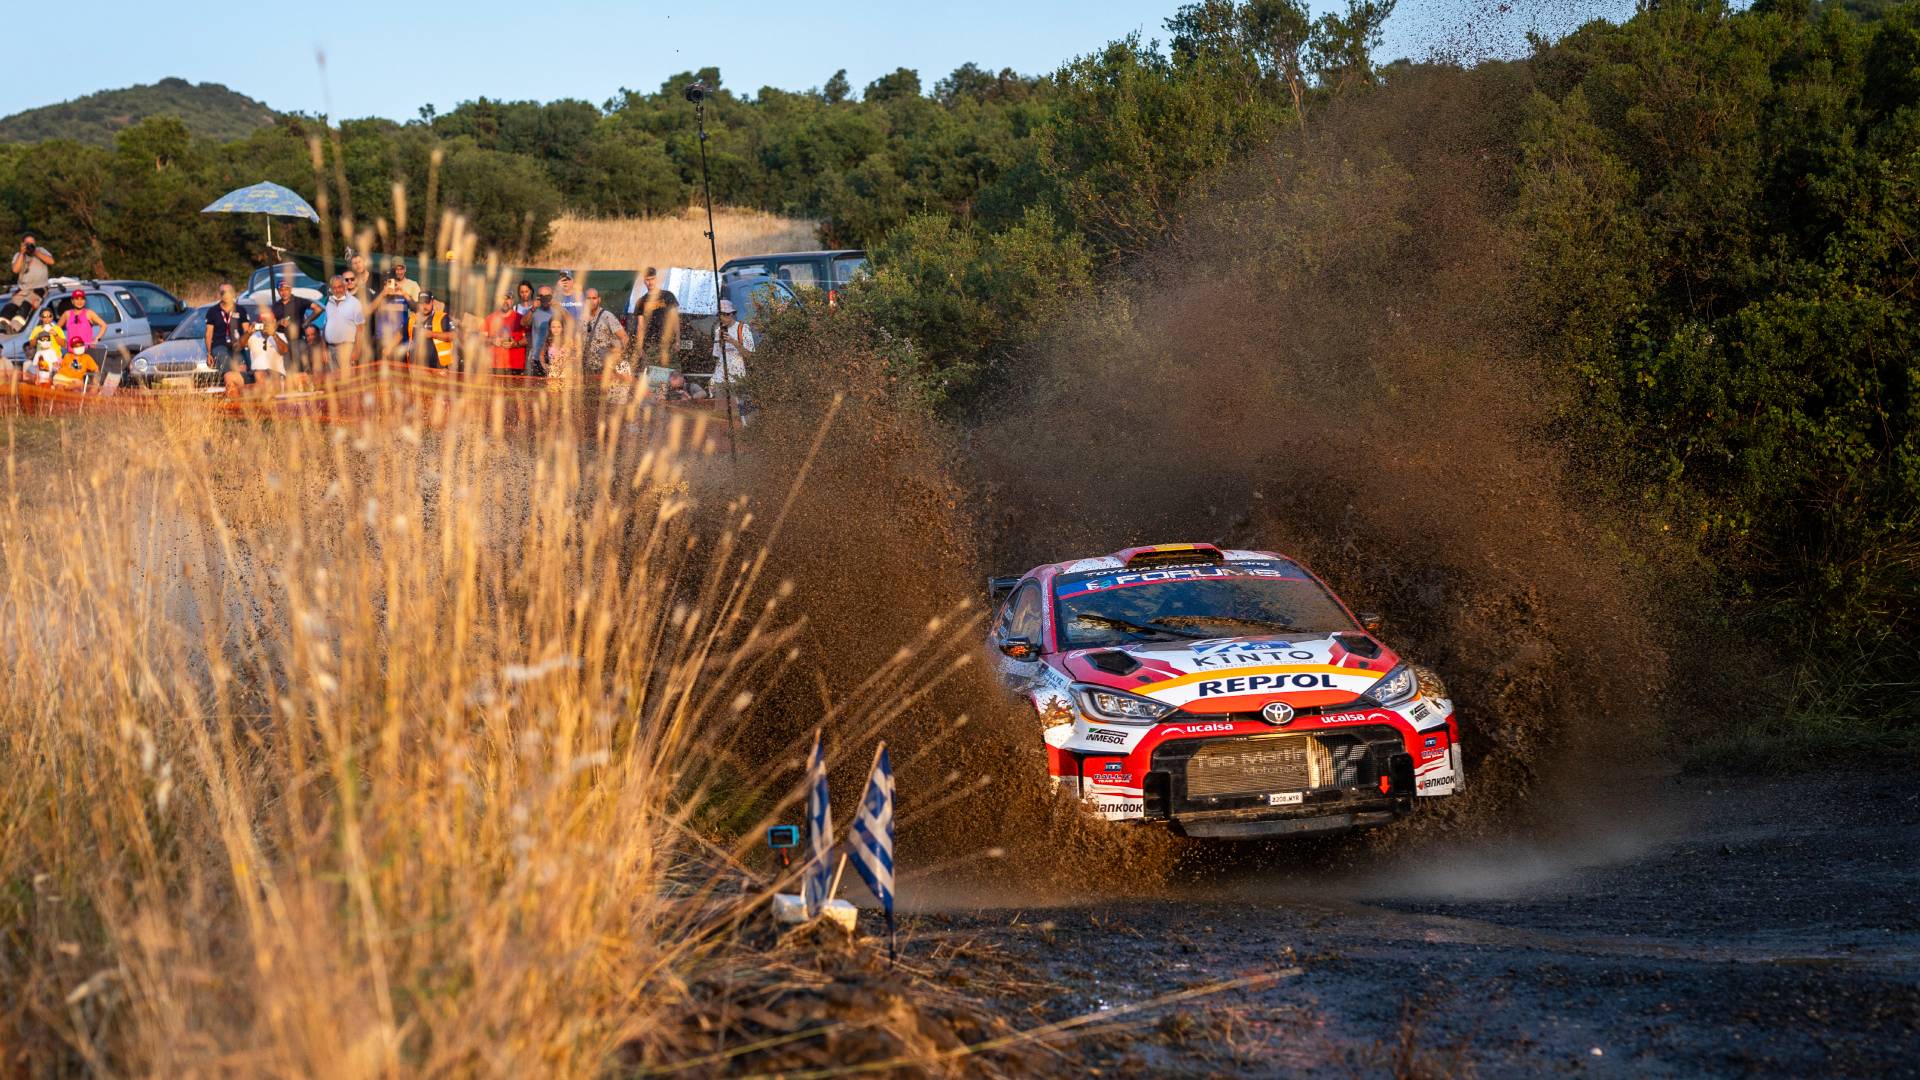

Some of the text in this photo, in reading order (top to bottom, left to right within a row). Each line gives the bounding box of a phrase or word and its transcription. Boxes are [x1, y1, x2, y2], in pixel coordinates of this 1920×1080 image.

[1199, 674, 1338, 697] REPSOL
[1320, 711, 1366, 724] ucalsa
[1186, 722, 1234, 734] ucalsa
